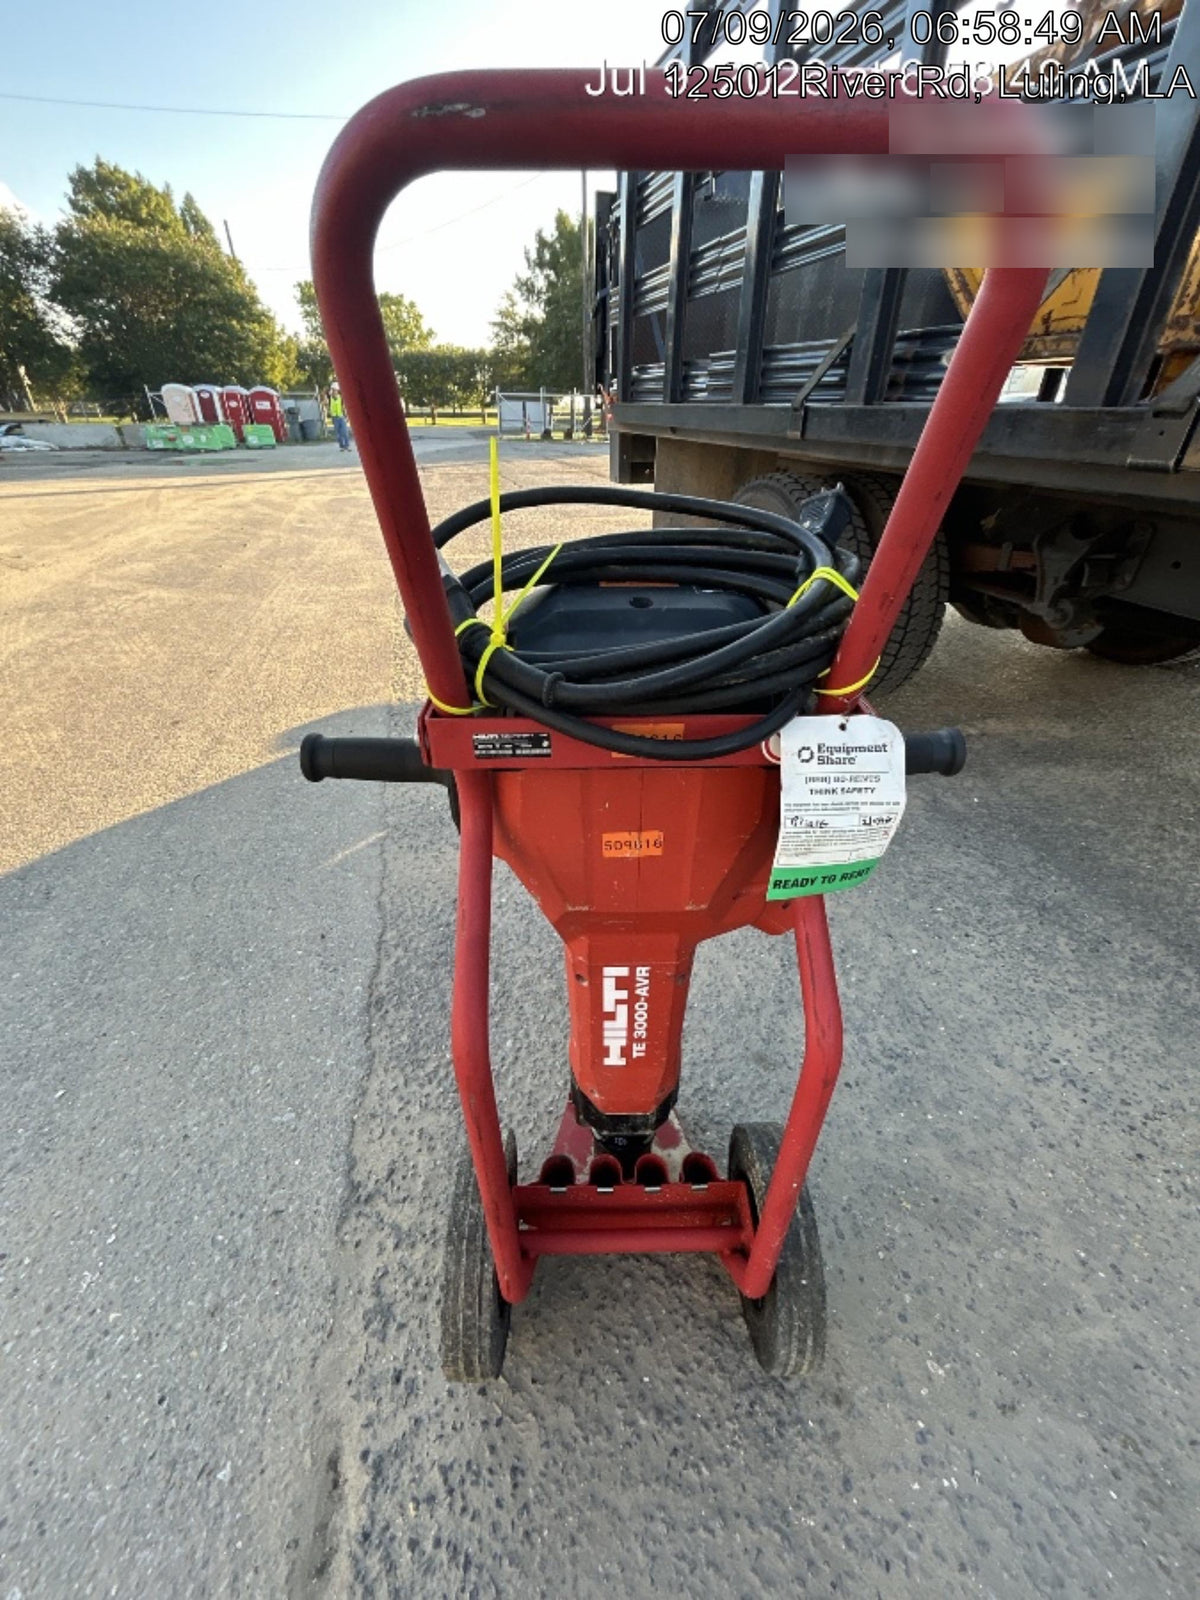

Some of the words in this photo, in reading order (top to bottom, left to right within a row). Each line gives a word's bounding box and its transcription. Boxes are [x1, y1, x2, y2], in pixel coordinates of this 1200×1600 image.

[817, 743, 888, 756] Equipment
[817, 755, 856, 765] Share
[773, 876, 818, 889] READY
[821, 874, 836, 884] TO
[633, 966, 651, 1040] 3000-AVR
[602, 966, 629, 1066] HILTI
[632, 1042, 646, 1059] TE
